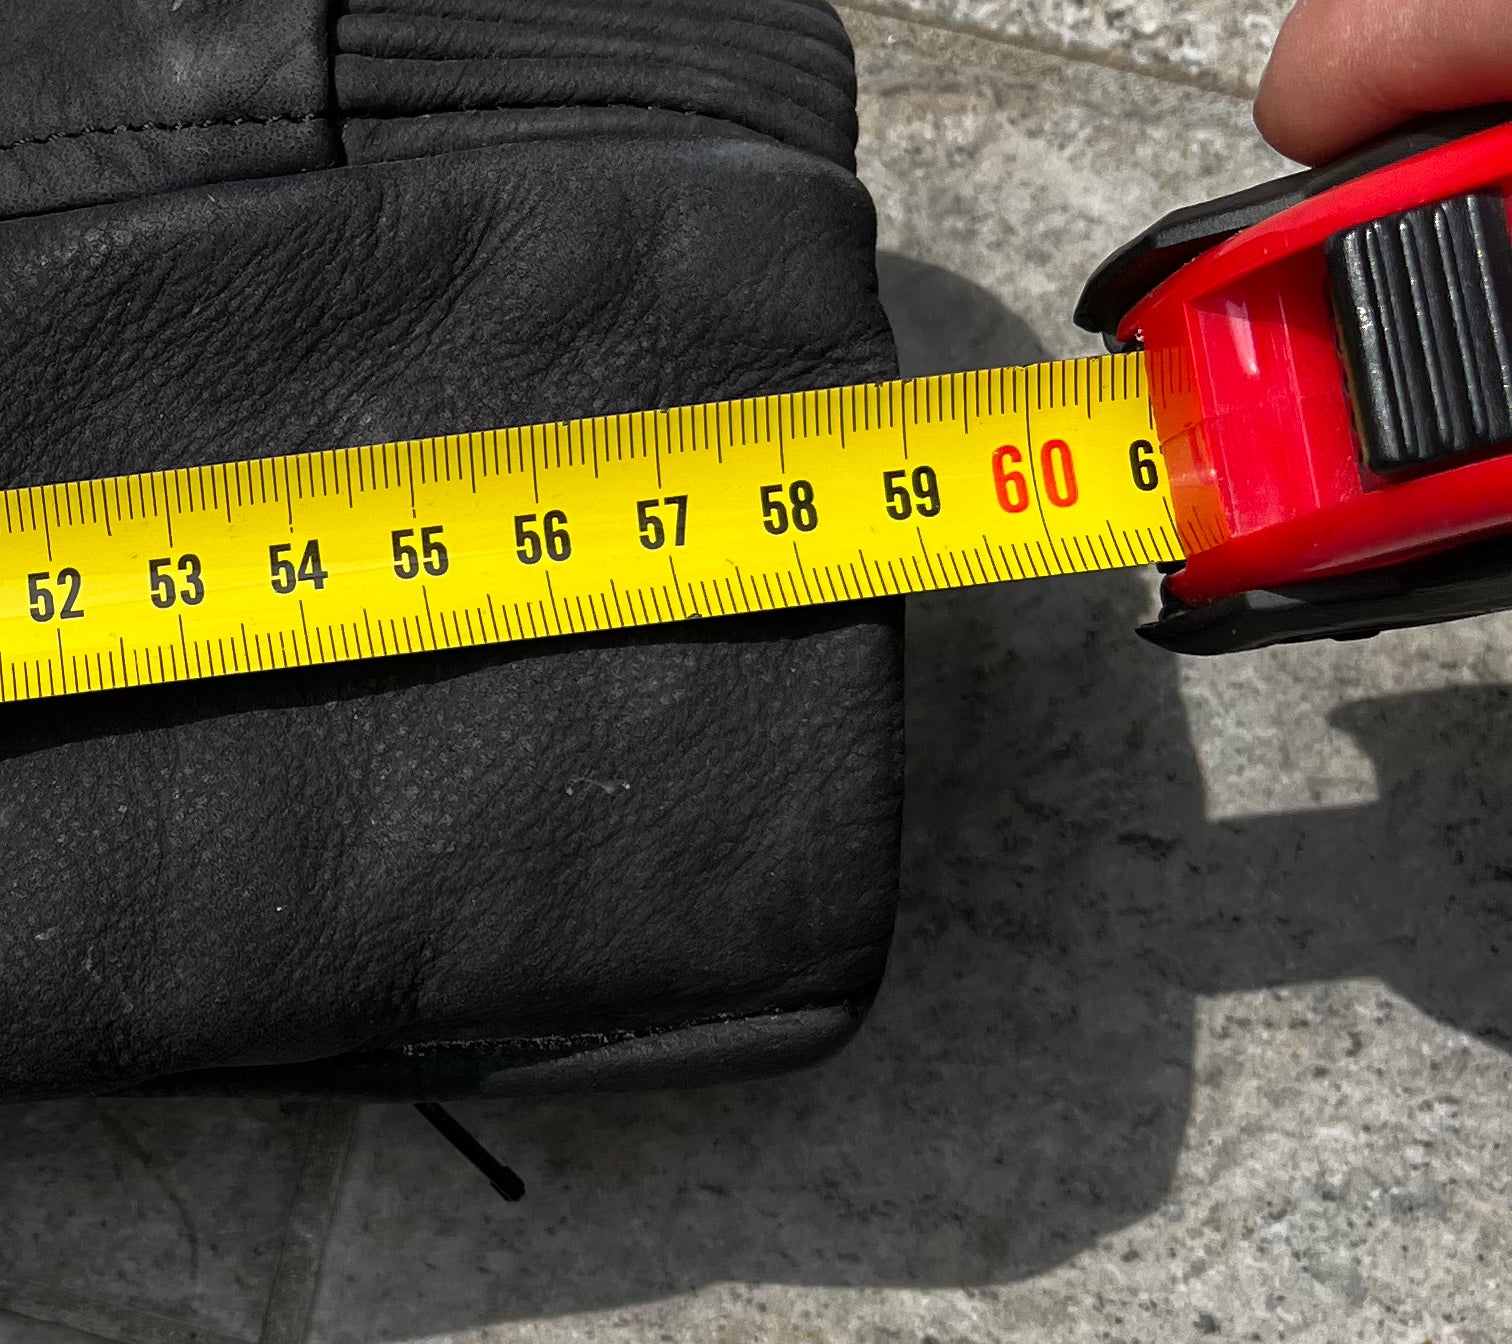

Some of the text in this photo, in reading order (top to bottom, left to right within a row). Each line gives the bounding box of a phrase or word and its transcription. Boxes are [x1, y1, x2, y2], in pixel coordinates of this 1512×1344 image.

[28, 568, 84, 622] 52
[149, 554, 204, 608] 53
[269, 540, 328, 593] 54
[392, 526, 448, 579] 55
[515, 510, 571, 564] 56
[637, 495, 687, 549] 57
[761, 480, 817, 535] 58
[883, 466, 940, 520] 59
[992, 439, 1078, 513] 60
[1129, 439, 1163, 492] 6
